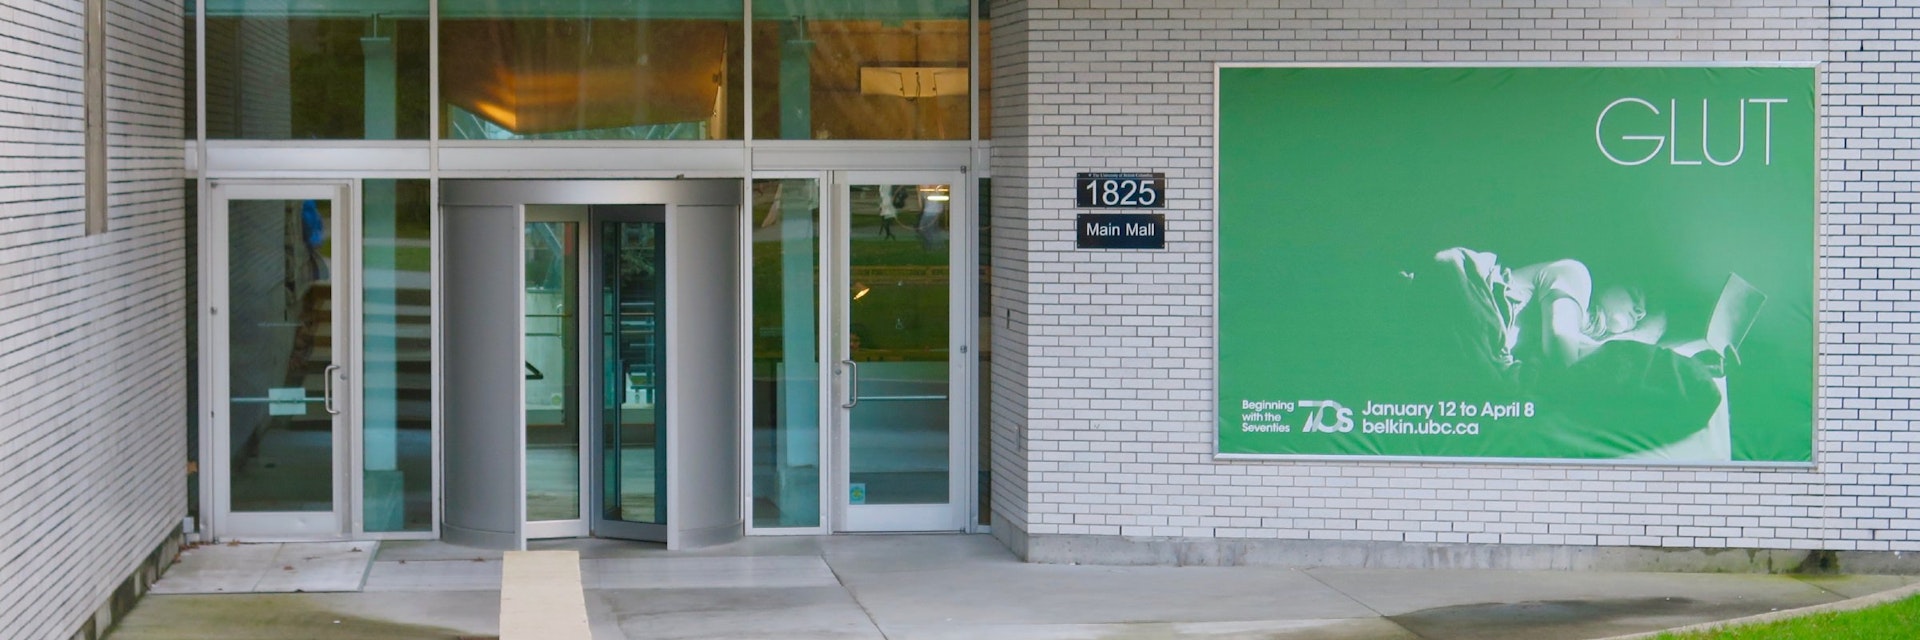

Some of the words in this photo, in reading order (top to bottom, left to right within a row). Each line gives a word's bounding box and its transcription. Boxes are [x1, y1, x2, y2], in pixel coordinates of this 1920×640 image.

[1596, 97, 1788, 166] GLUT
[1086, 180, 1156, 205] 1825
[1086, 222, 1120, 236] Main
[1126, 222, 1155, 236] Mall
[1242, 400, 1295, 412] Beginning
[1362, 400, 1433, 419] January
[1438, 401, 1457, 416] 12
[1460, 402, 1477, 417] to
[1480, 402, 1520, 420] April
[1524, 402, 1535, 417] 8
[1242, 411, 1264, 422] with
[1264, 411, 1281, 422] the
[1242, 422, 1290, 433] Seventies
[1362, 418, 1479, 435] belkin.ubc.ca
